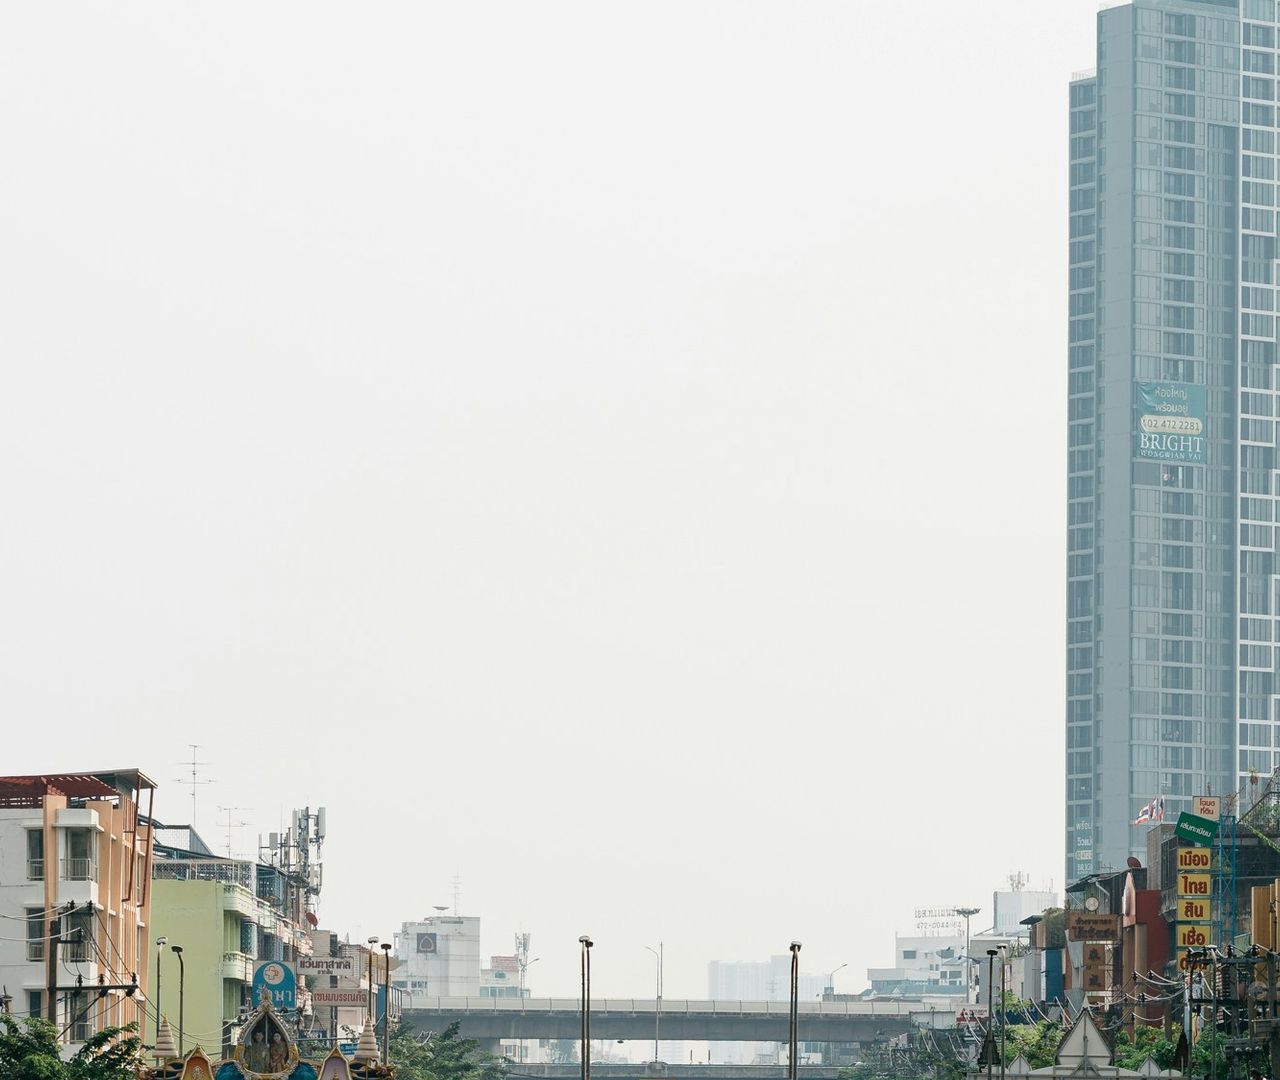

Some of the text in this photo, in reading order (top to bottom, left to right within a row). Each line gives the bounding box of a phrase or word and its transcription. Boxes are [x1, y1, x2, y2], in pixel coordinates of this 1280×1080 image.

[1161, 420, 1176, 430] 472
[1179, 420, 1200, 432] 2281
[1140, 433, 1204, 452] BRIGHT
[1180, 850, 1209, 866] เมือง
[1182, 875, 1207, 894] ไทย
[1184, 902, 1204, 918] สิน
[1182, 926, 1206, 945] เชื่อ
